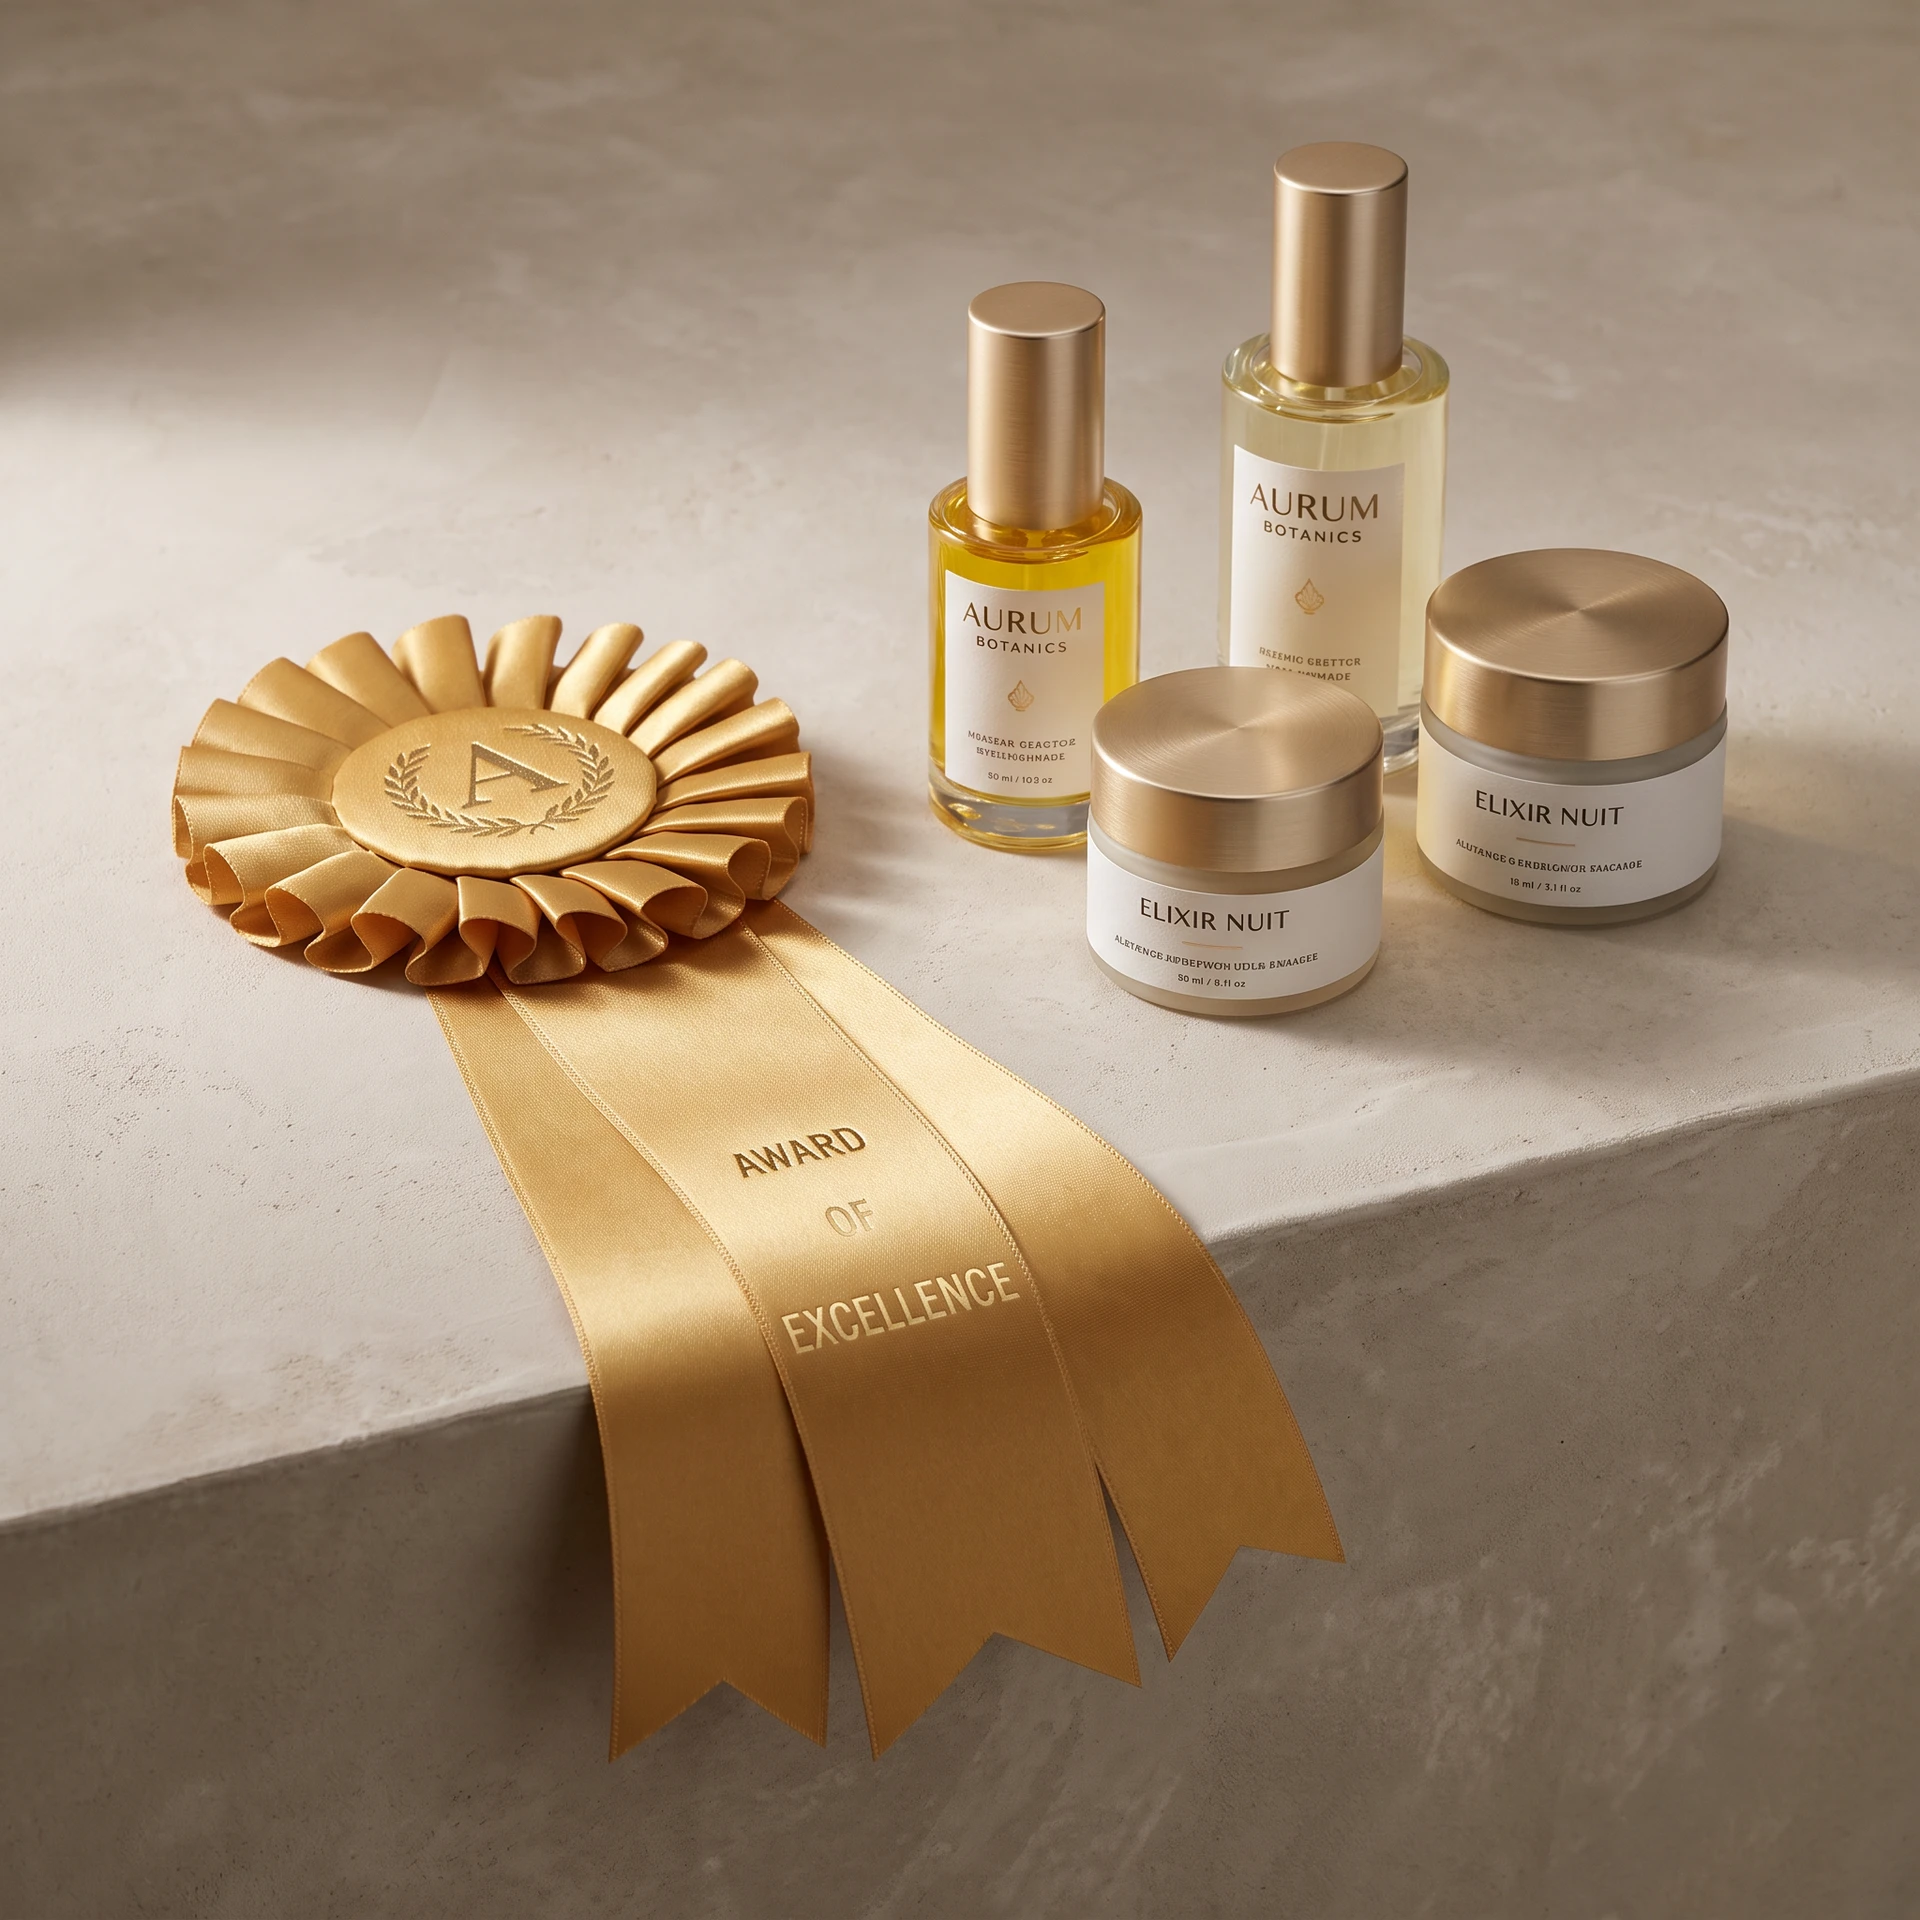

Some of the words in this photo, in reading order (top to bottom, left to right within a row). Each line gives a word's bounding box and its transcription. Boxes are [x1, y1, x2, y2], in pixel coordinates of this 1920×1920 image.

[1250, 483, 1379, 522] AURUM
[1263, 520, 1362, 543] BOTANICS
[962, 602, 1082, 635] AURUM
[976, 635, 1067, 654] BOTANICS
[462, 741, 570, 809] A
[1475, 789, 1552, 825] ELIXIR
[1561, 806, 1624, 827] NUIT
[1510, 877, 1520, 886] 18
[1522, 881, 1534, 889] ml
[1140, 897, 1217, 931] ELIXIR
[1227, 909, 1290, 932] NUIT
[1191, 977, 1203, 985] ml
[732, 1127, 866, 1178] AWARD
[824, 1198, 873, 1238] OF
[781, 1261, 1020, 1355] EXCELLENCE
